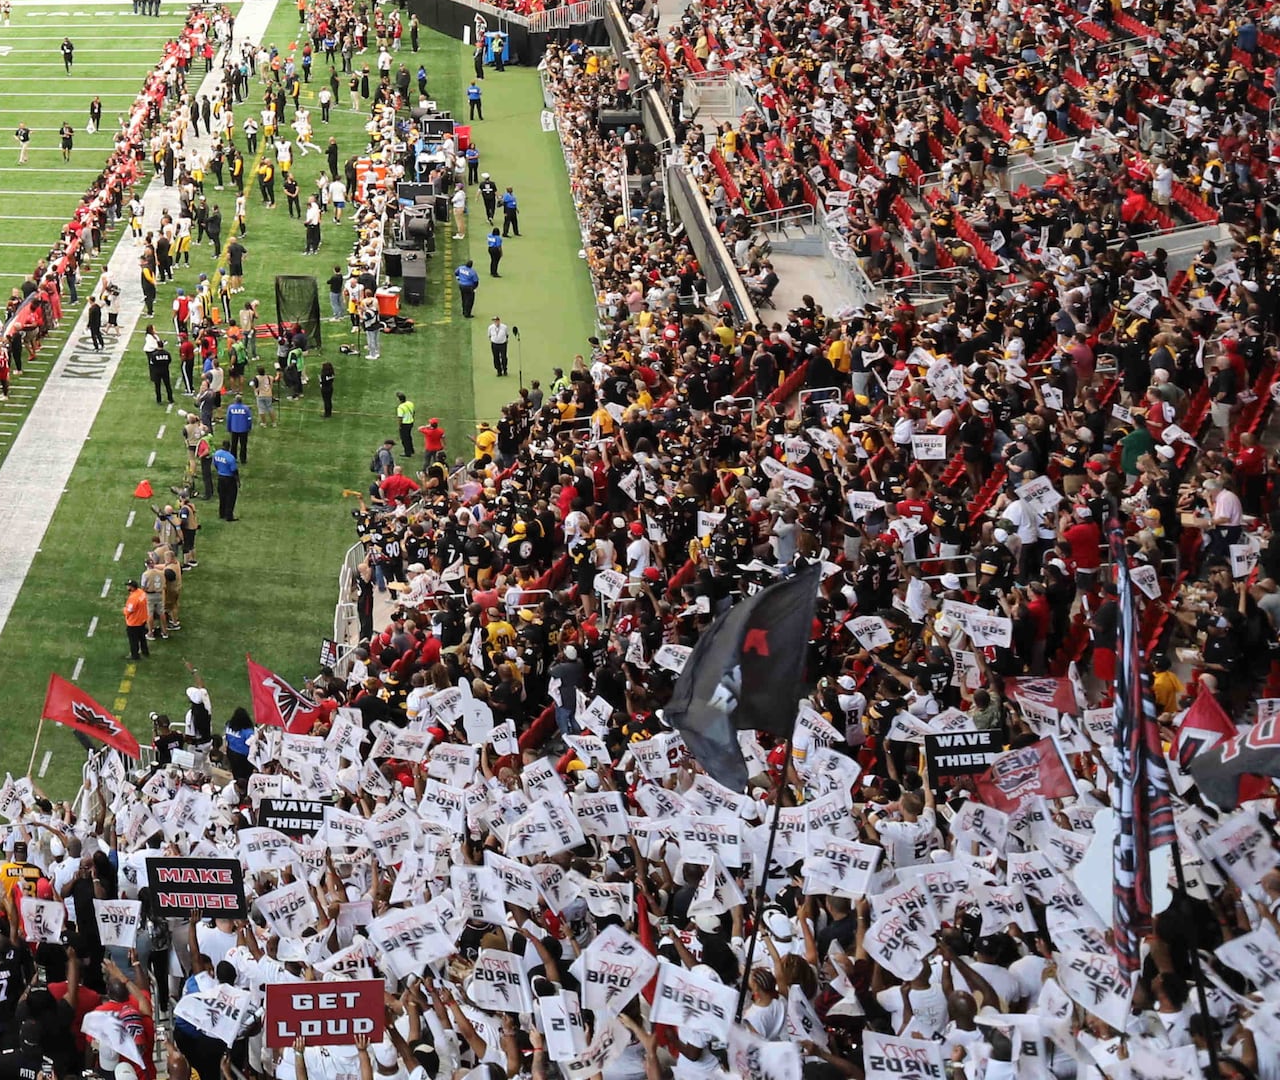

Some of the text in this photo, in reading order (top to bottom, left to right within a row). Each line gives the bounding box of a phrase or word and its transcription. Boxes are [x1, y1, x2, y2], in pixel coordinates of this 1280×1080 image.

[914, 442, 943, 450] BIRDS
[385, 541, 400, 557] 90
[854, 622, 882, 637] BIRDS
[971, 624, 1006, 636] BIRDS
[935, 732, 991, 747] WAVE
[271, 799, 323, 813] WAVE
[266, 817, 323, 830] THOSE
[809, 805, 849, 831] BIRDS
[375, 833, 409, 850] BIRDS
[157, 867, 233, 883] MAKE
[157, 892, 239, 909] NOISE
[383, 921, 437, 953] BIRDS
[598, 959, 639, 976] DIRTY
[292, 992, 361, 1011] GET
[661, 985, 724, 1020] BIRDS
[277, 1018, 375, 1037] LOUD
